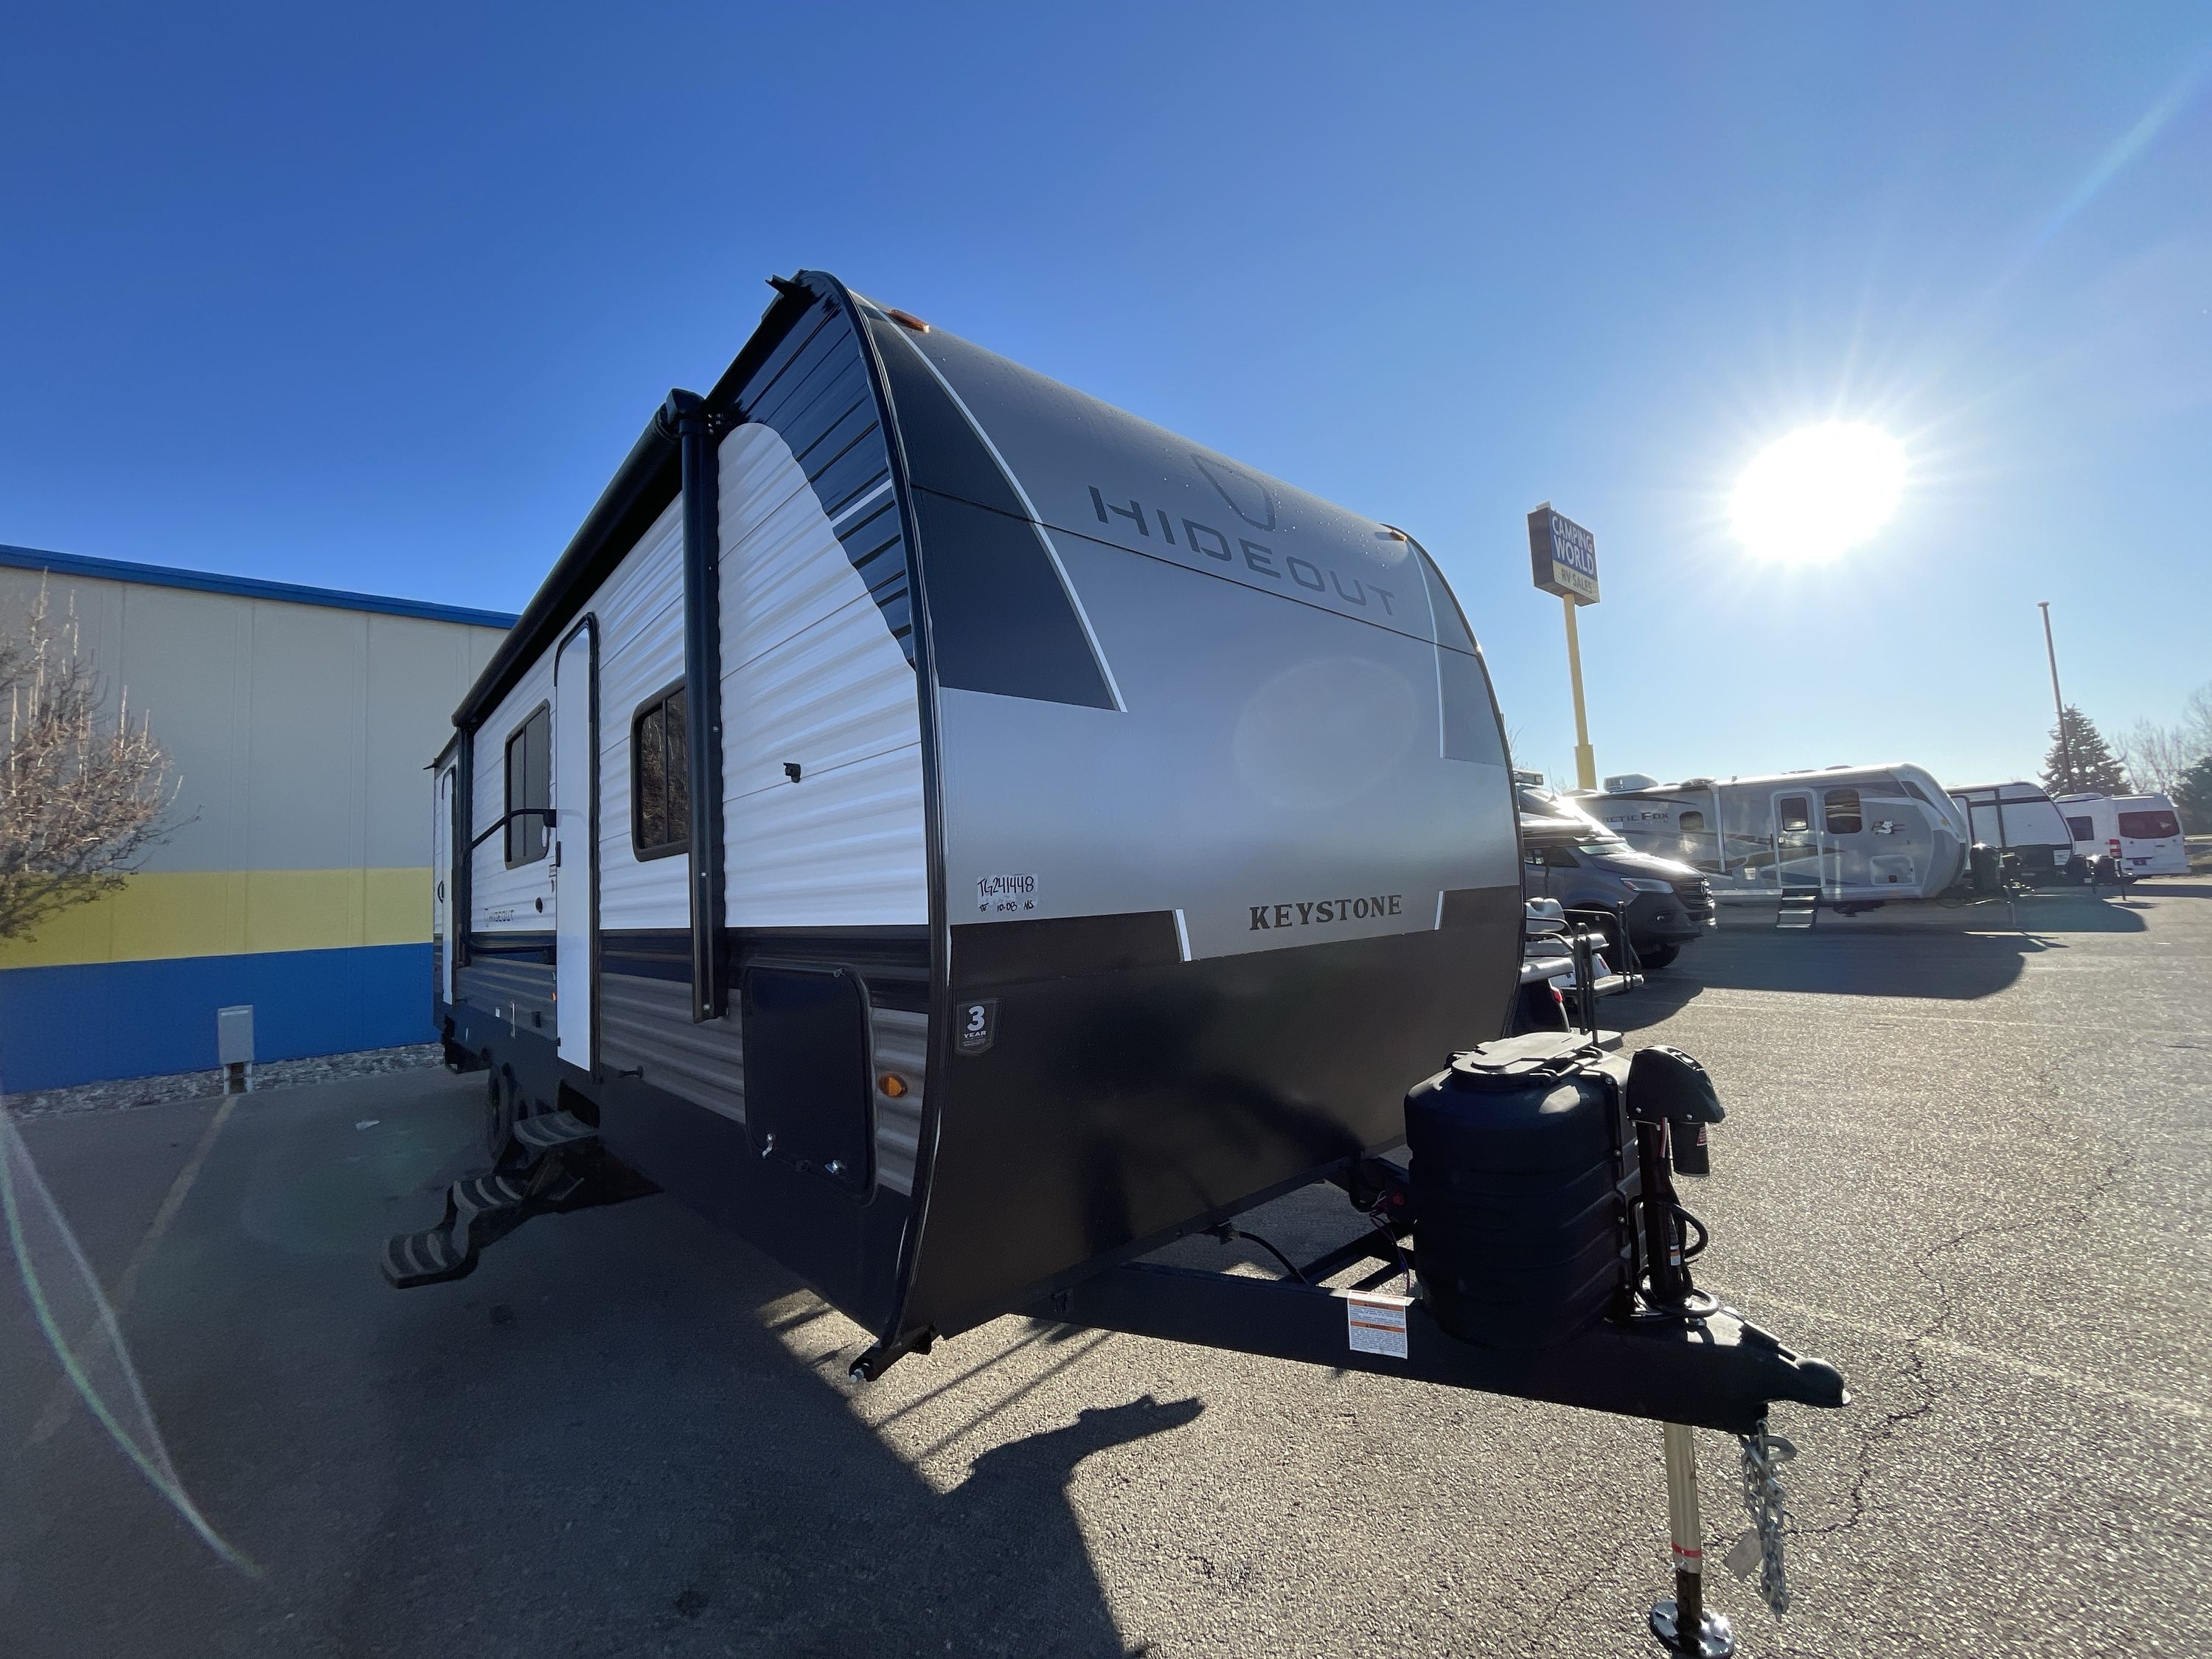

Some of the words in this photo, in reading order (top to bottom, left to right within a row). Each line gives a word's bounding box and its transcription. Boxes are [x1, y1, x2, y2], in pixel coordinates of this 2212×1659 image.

[1088, 484, 1394, 616] HIDEOUT
[1552, 515, 1593, 554] CAMPING
[1554, 535, 1594, 574] WORLD
[1561, 568, 1571, 583] RV
[1573, 573, 1593, 594] SALES
[1249, 894, 1402, 931] KEYSTONE
[964, 1030, 987, 1039] YEAR
[967, 1005, 985, 1031] 3
